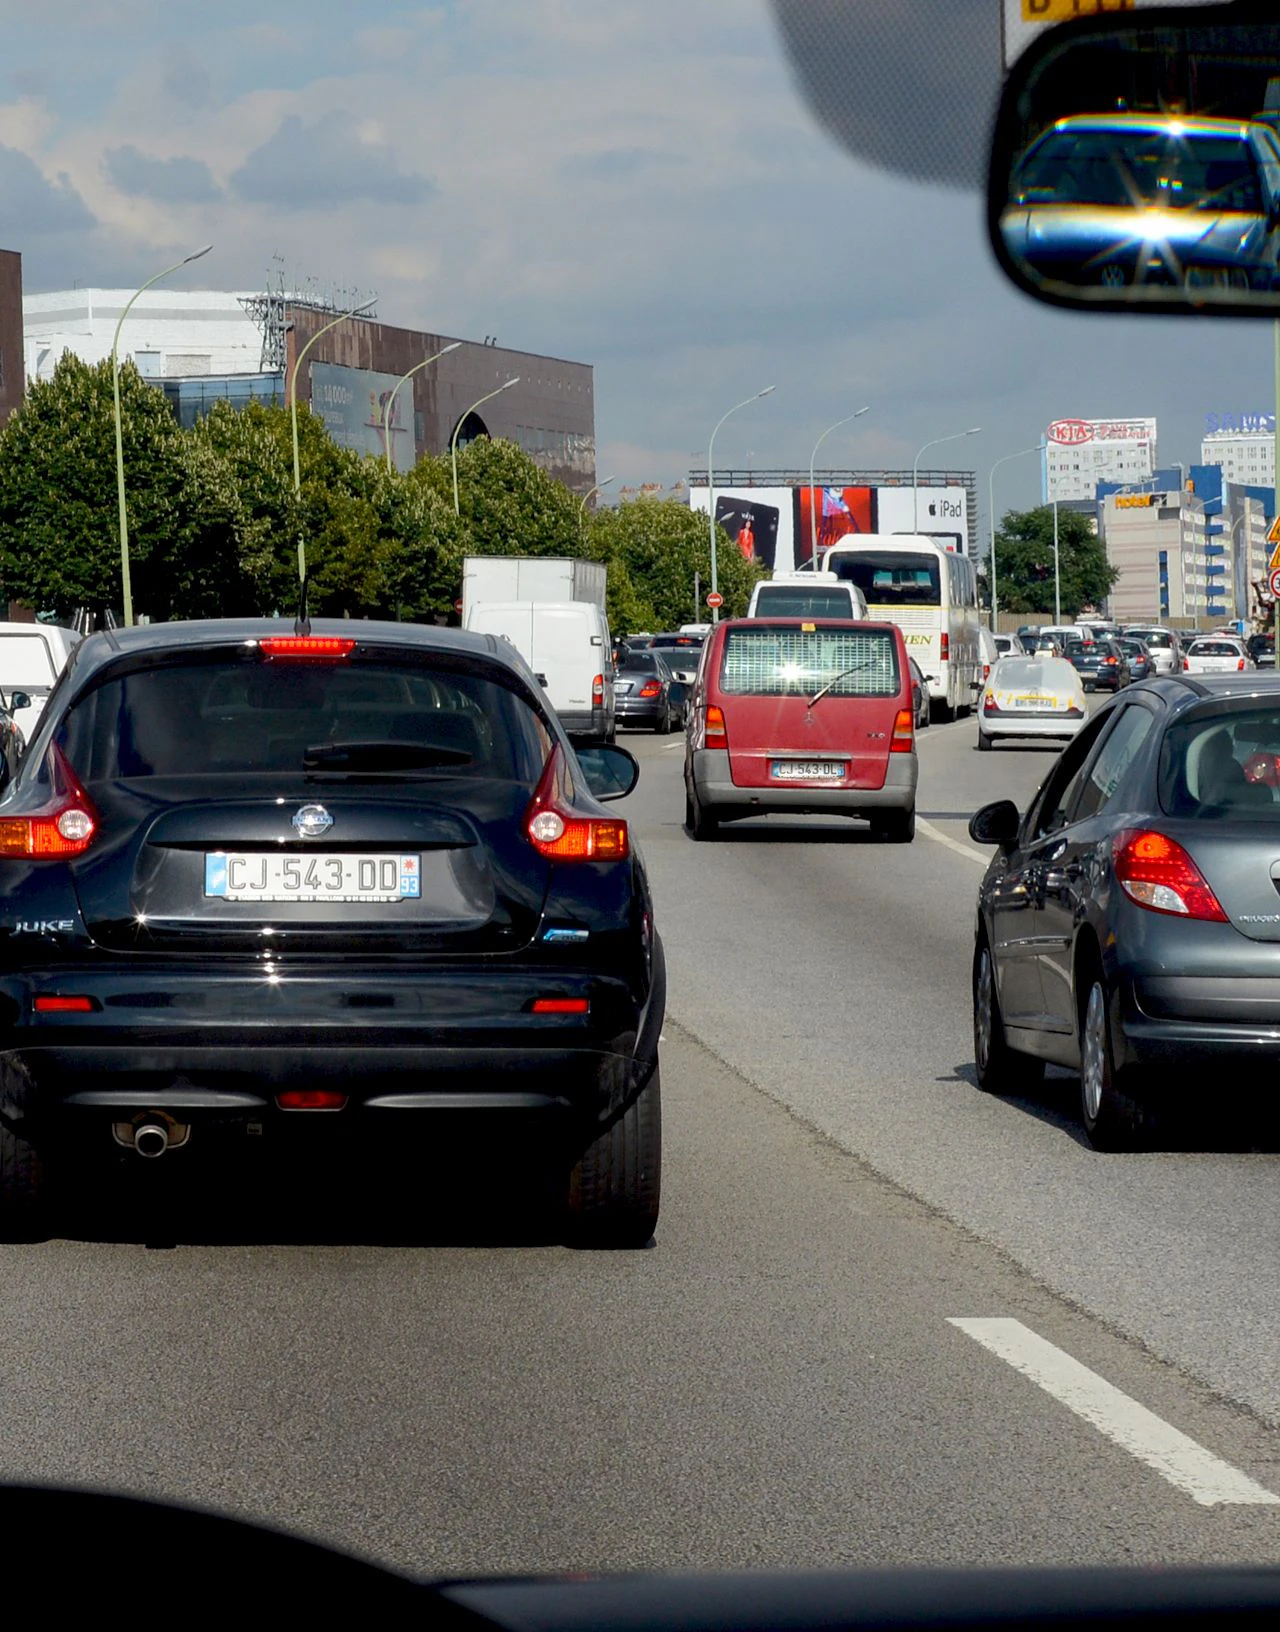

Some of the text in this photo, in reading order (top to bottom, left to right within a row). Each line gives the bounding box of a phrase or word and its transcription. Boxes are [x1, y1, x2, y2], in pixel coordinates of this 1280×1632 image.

[1056, 426, 1087, 439] KIA
[940, 499, 962, 518] iPad
[1115, 496, 1151, 509] hotel
[779, 762, 837, 775] CJ-543-DL
[228, 858, 397, 890] CJ-543-DD
[401, 876, 418, 894] 93
[9, 919, 74, 937] JUKE
